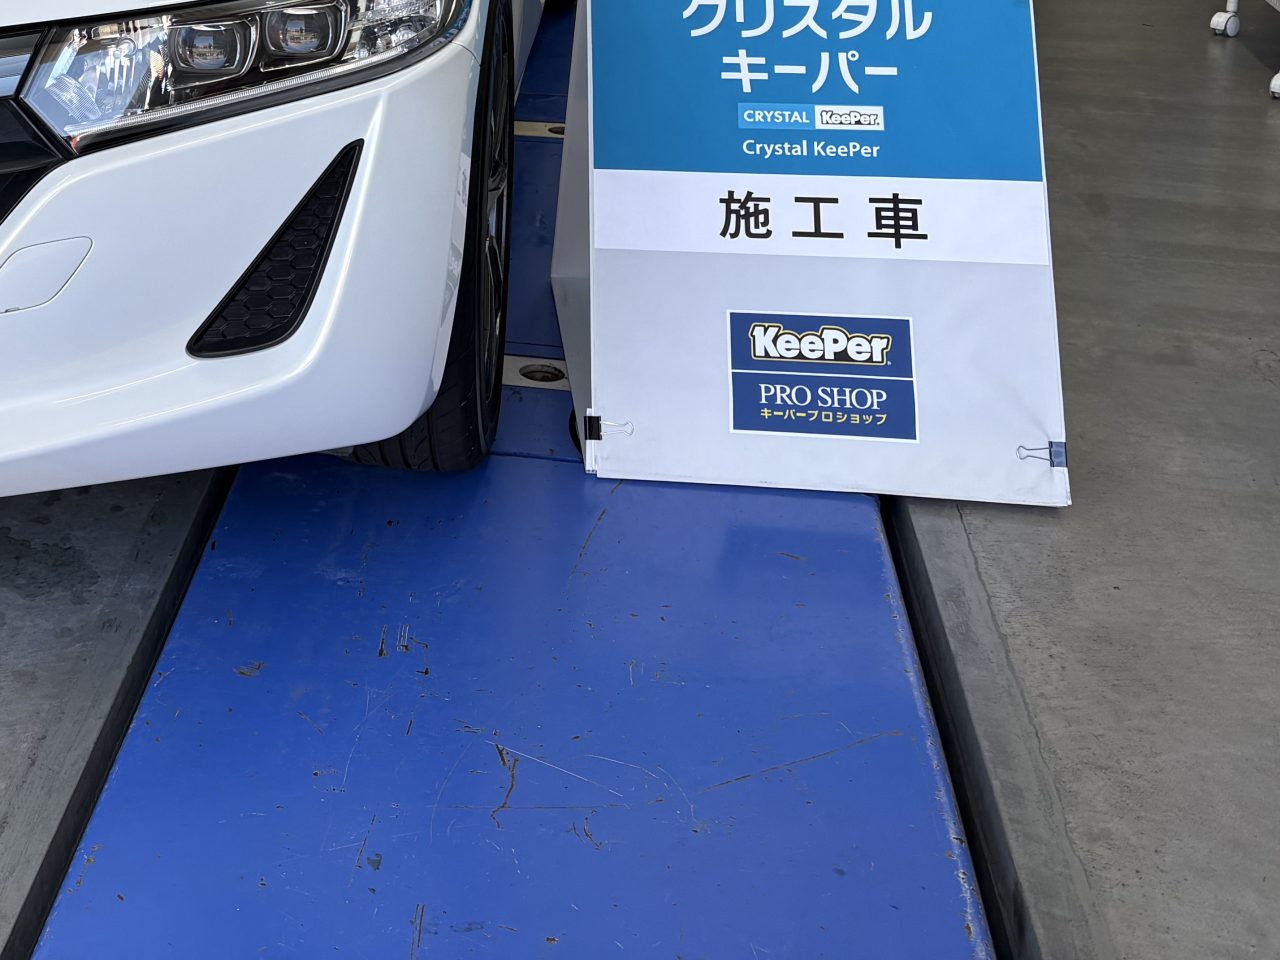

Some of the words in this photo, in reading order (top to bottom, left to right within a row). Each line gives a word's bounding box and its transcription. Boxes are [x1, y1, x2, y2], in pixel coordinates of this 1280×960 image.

[721, 49, 898, 95] キーパー
[743, 110, 810, 124] CRYSTAL
[820, 110, 878, 126] KeePer
[742, 140, 808, 158] Crystal
[813, 141, 880, 158] KeePer
[719, 190, 928, 249] 施工車
[750, 323, 892, 366] KeePer
[759, 383, 812, 406] PRO
[817, 386, 887, 410] SHOP
[760, 407, 887, 426] キーパープロショップ
